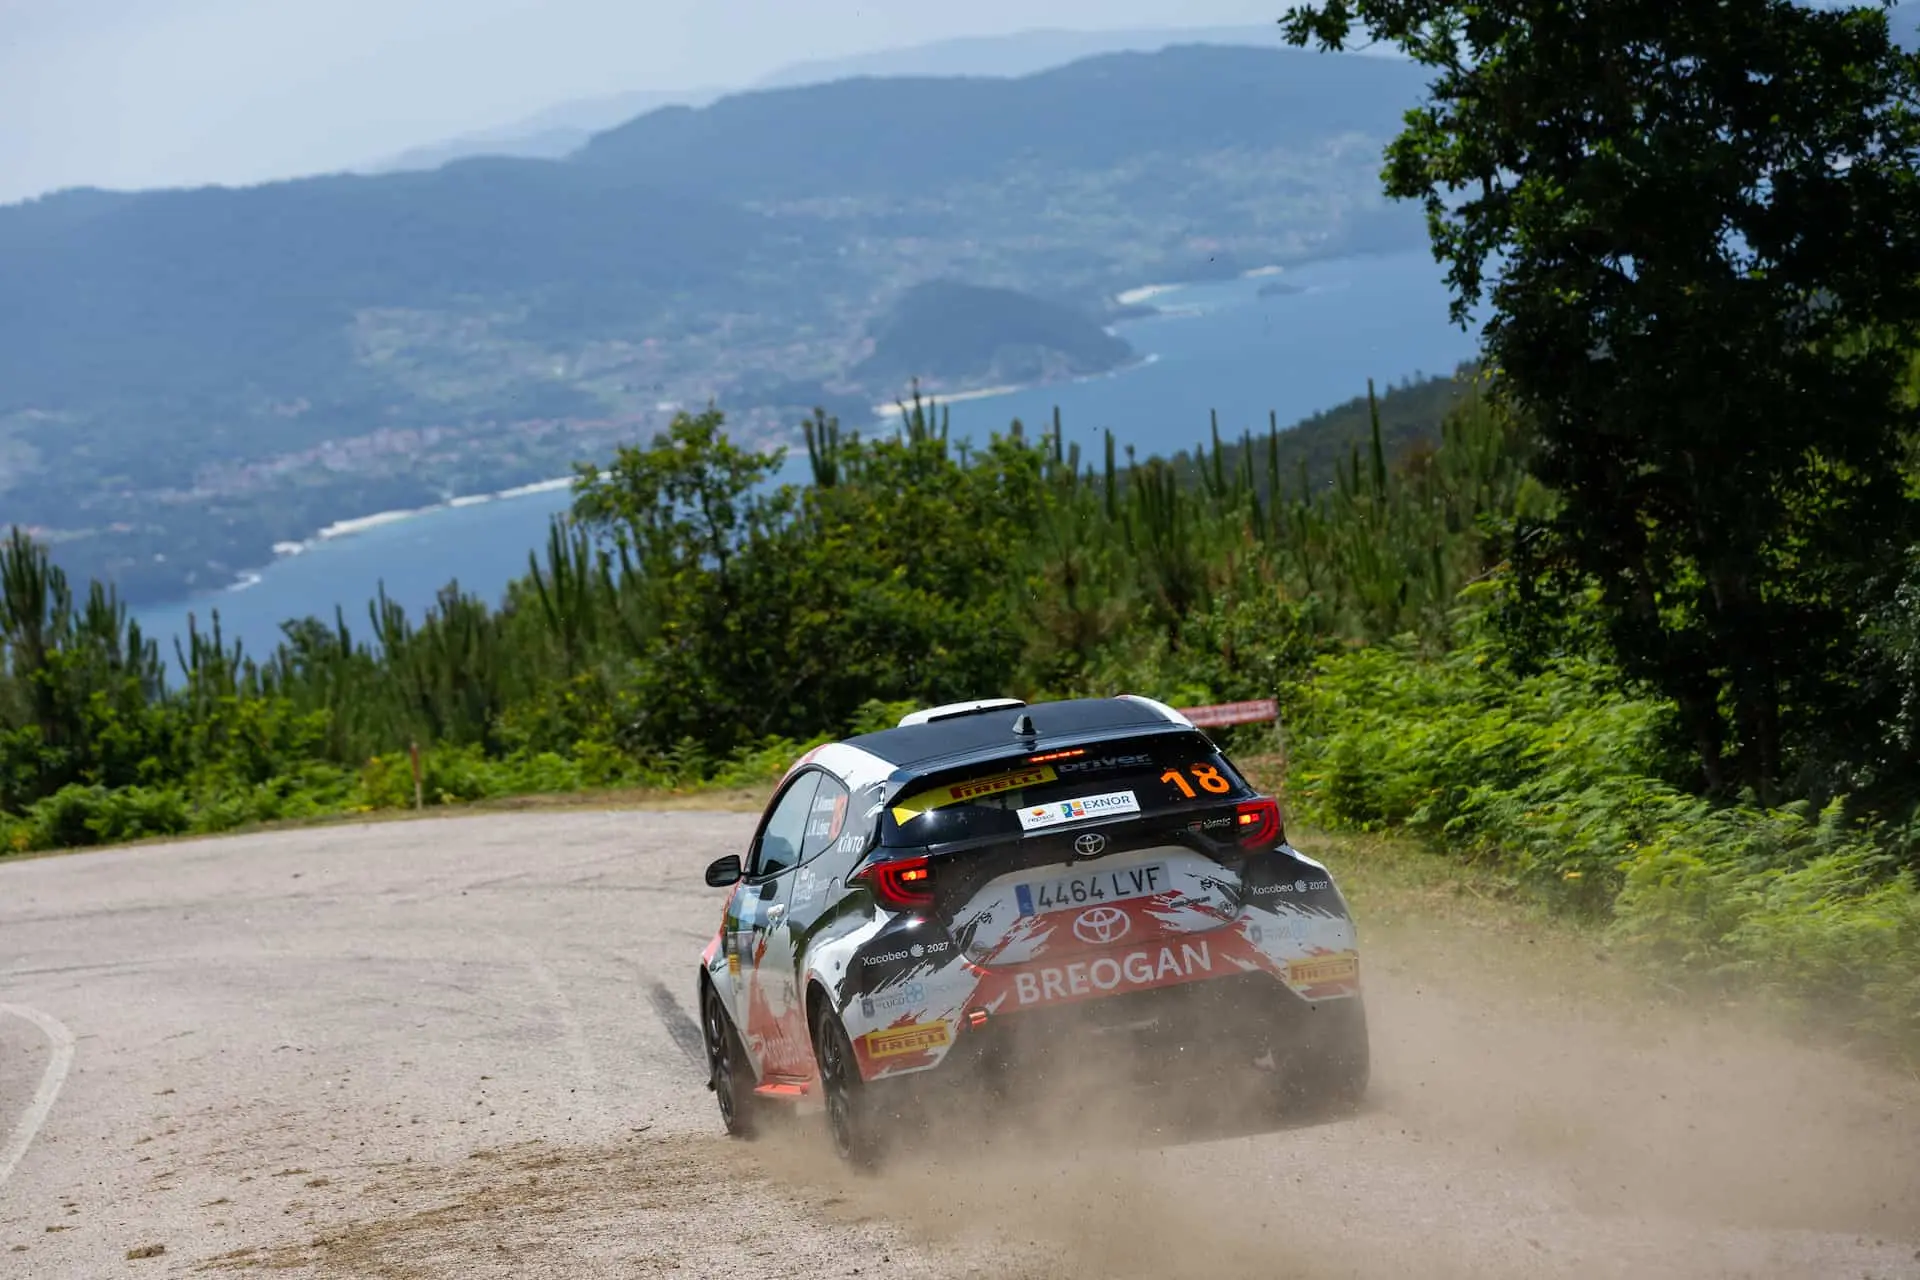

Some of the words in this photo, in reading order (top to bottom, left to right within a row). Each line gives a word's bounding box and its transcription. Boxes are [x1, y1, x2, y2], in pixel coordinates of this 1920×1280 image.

[950, 767, 1045, 799] PIRELLI
[1160, 762, 1231, 799] 18
[1083, 795, 1131, 809] EXNOR
[1037, 877, 1105, 908] 4464
[1112, 866, 1161, 897] LVF
[1251, 884, 1294, 896] Xacobeo
[1309, 881, 1328, 890] 2027
[862, 950, 909, 967] Xacobeo
[927, 942, 950, 954] 2027
[1015, 941, 1213, 1005] BREOGAN
[870, 1025, 947, 1055] PIRELLI
